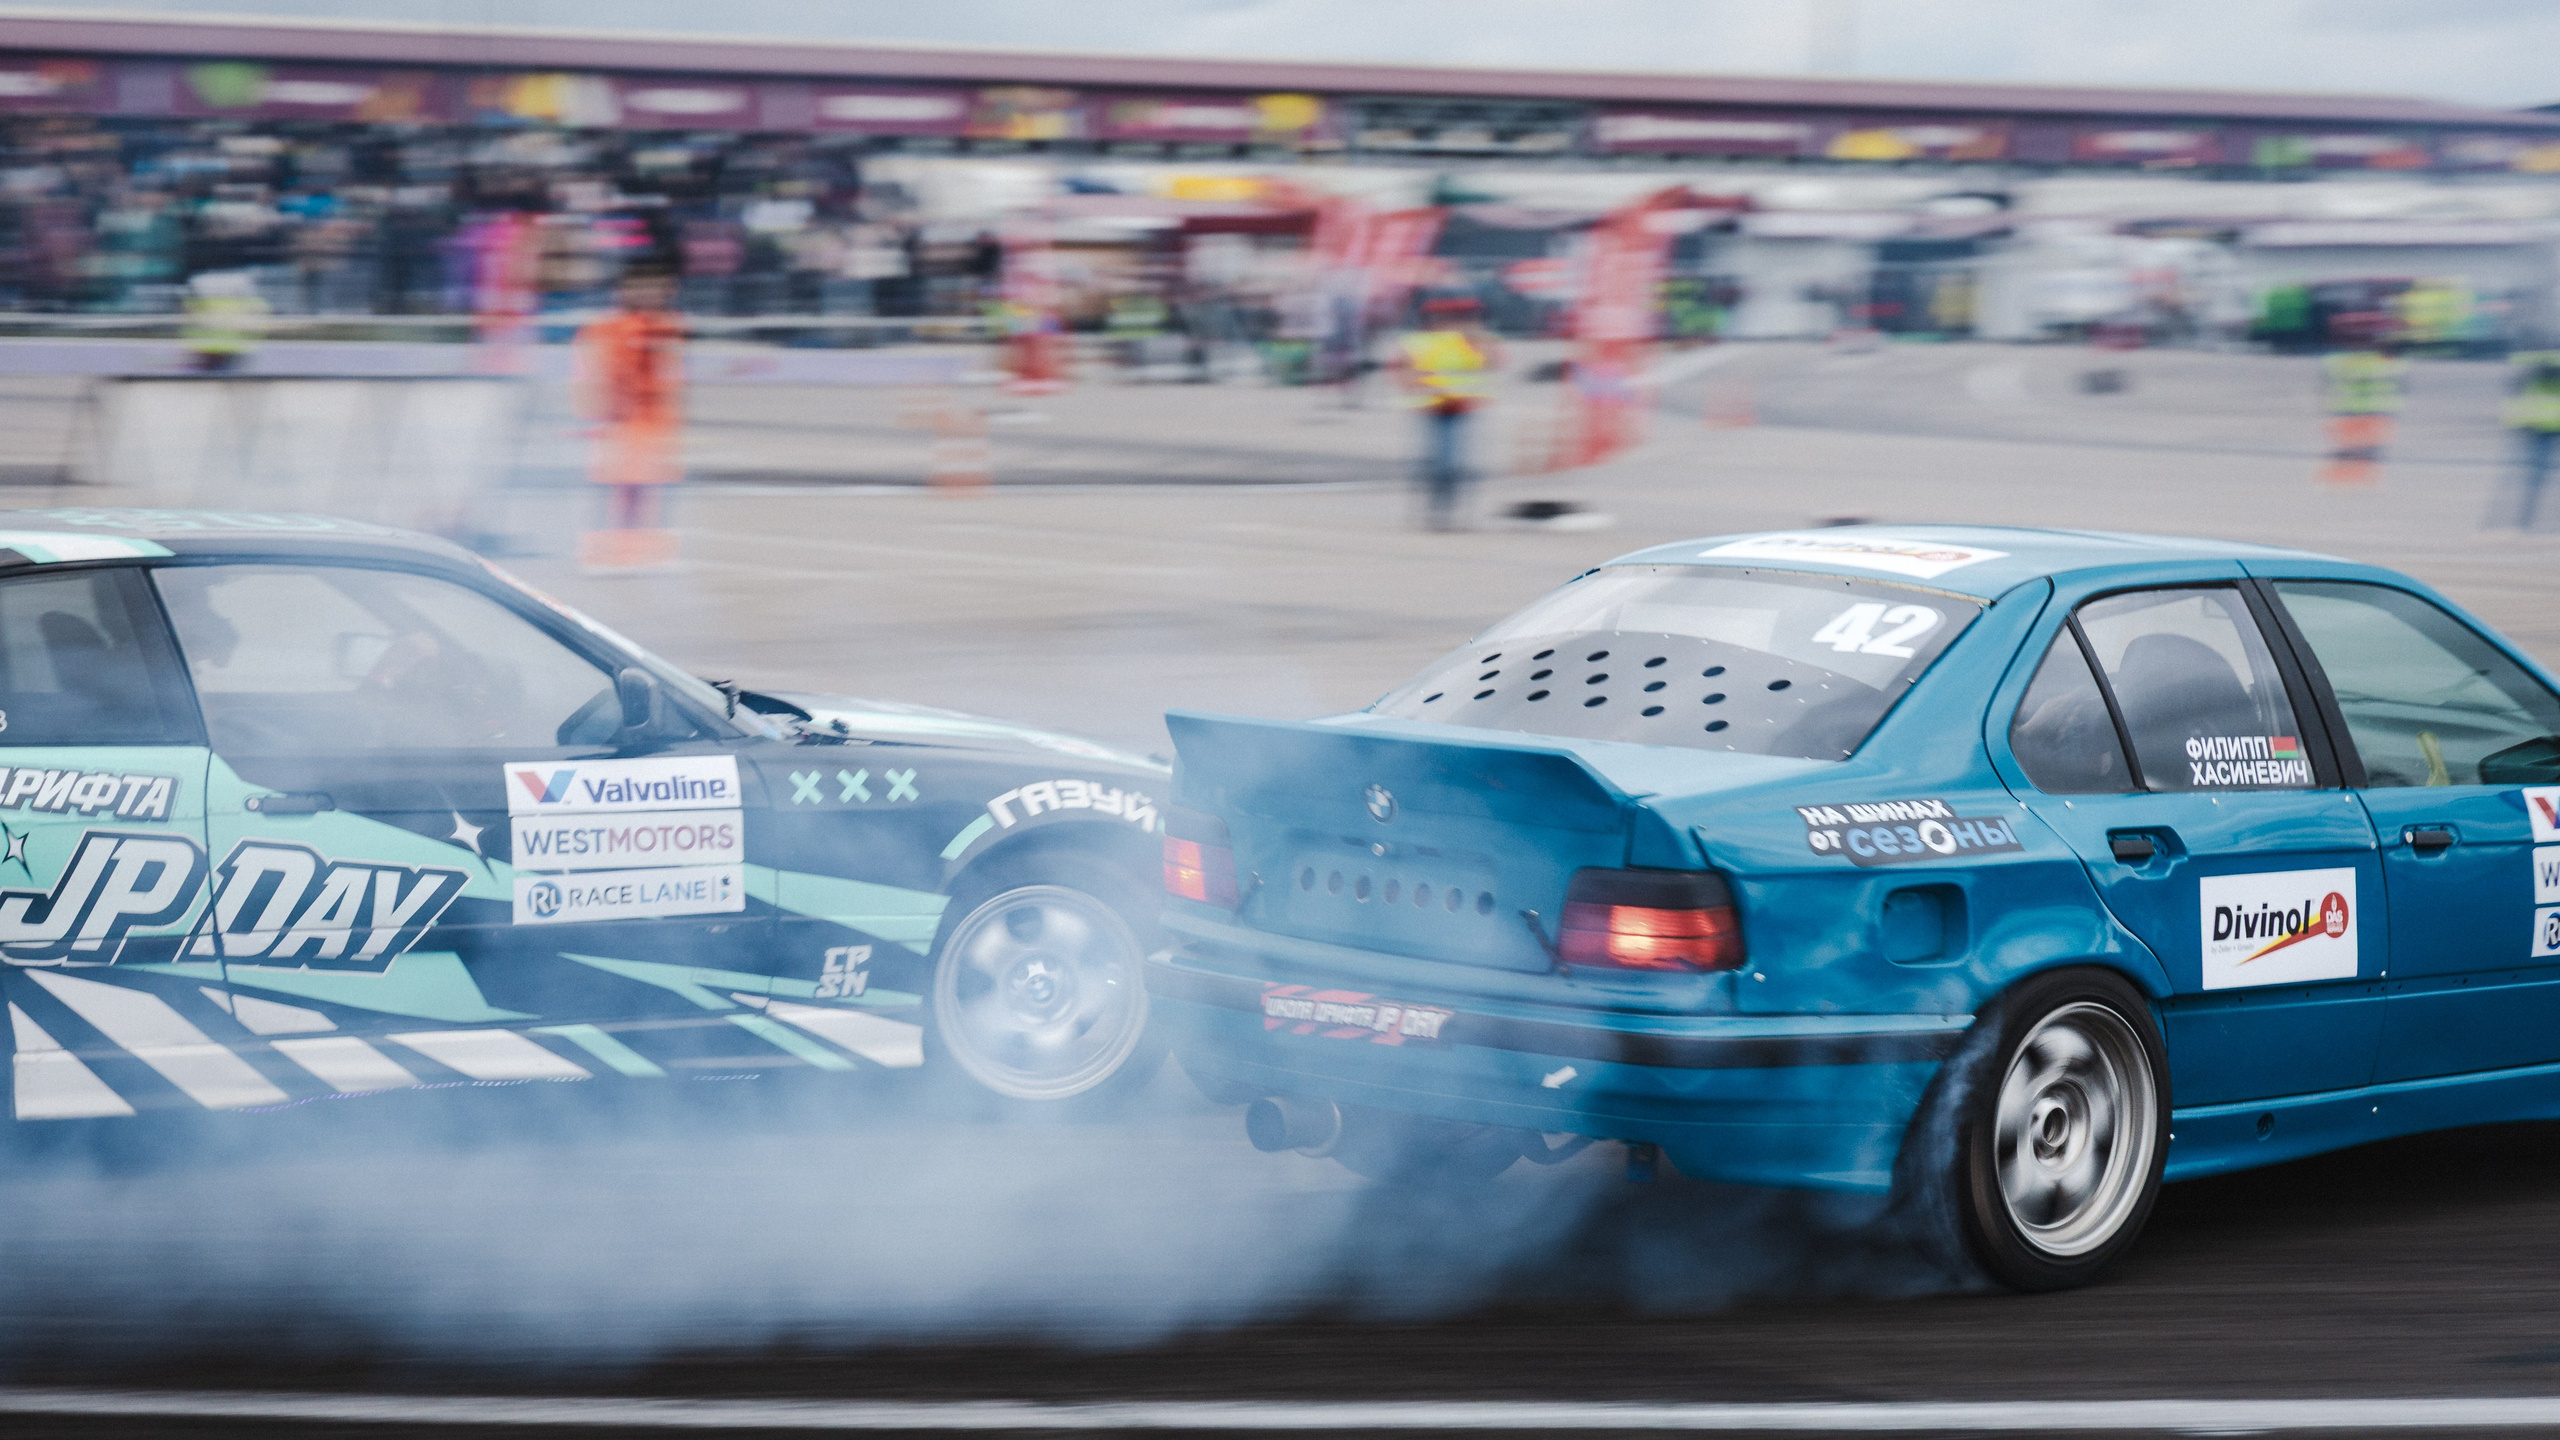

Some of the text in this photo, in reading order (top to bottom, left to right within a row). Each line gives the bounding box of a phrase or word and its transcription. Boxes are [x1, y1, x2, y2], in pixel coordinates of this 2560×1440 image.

[1812, 602, 1939, 659] 42
[2186, 736, 2269, 760] ФИЛИПП
[2190, 760, 2308, 785] ХАСИНЕВИЧ
[583, 775, 727, 803] Valvoline
[986, 779, 1158, 833] ГАЗУЙ
[1798, 799, 1953, 826] НА ШИНАХ
[522, 824, 735, 855] WESTMOTORS
[0, 836, 449, 961] JP DAY
[568, 884, 633, 908] RACE
[639, 880, 707, 902] LANE
[2213, 899, 2311, 941] Divinol
